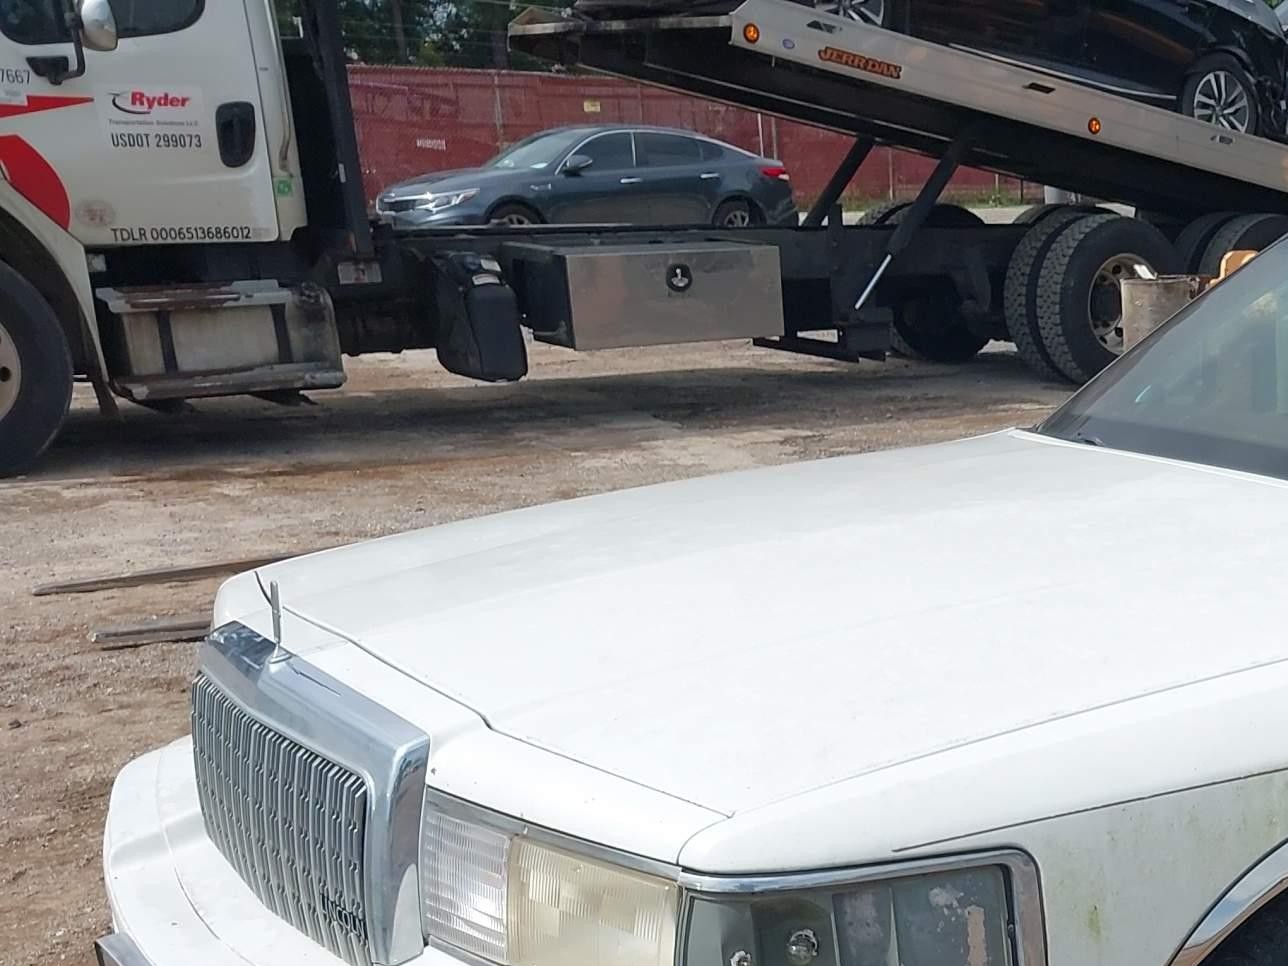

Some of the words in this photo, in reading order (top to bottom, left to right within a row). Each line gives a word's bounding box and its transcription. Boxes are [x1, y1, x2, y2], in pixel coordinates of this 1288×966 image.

[131, 91, 189, 110] Ryder
[111, 133, 150, 148] USDOT
[155, 133, 202, 148] 299073
[111, 227, 148, 242] TDLR
[150, 226, 252, 241] 0006513686012
